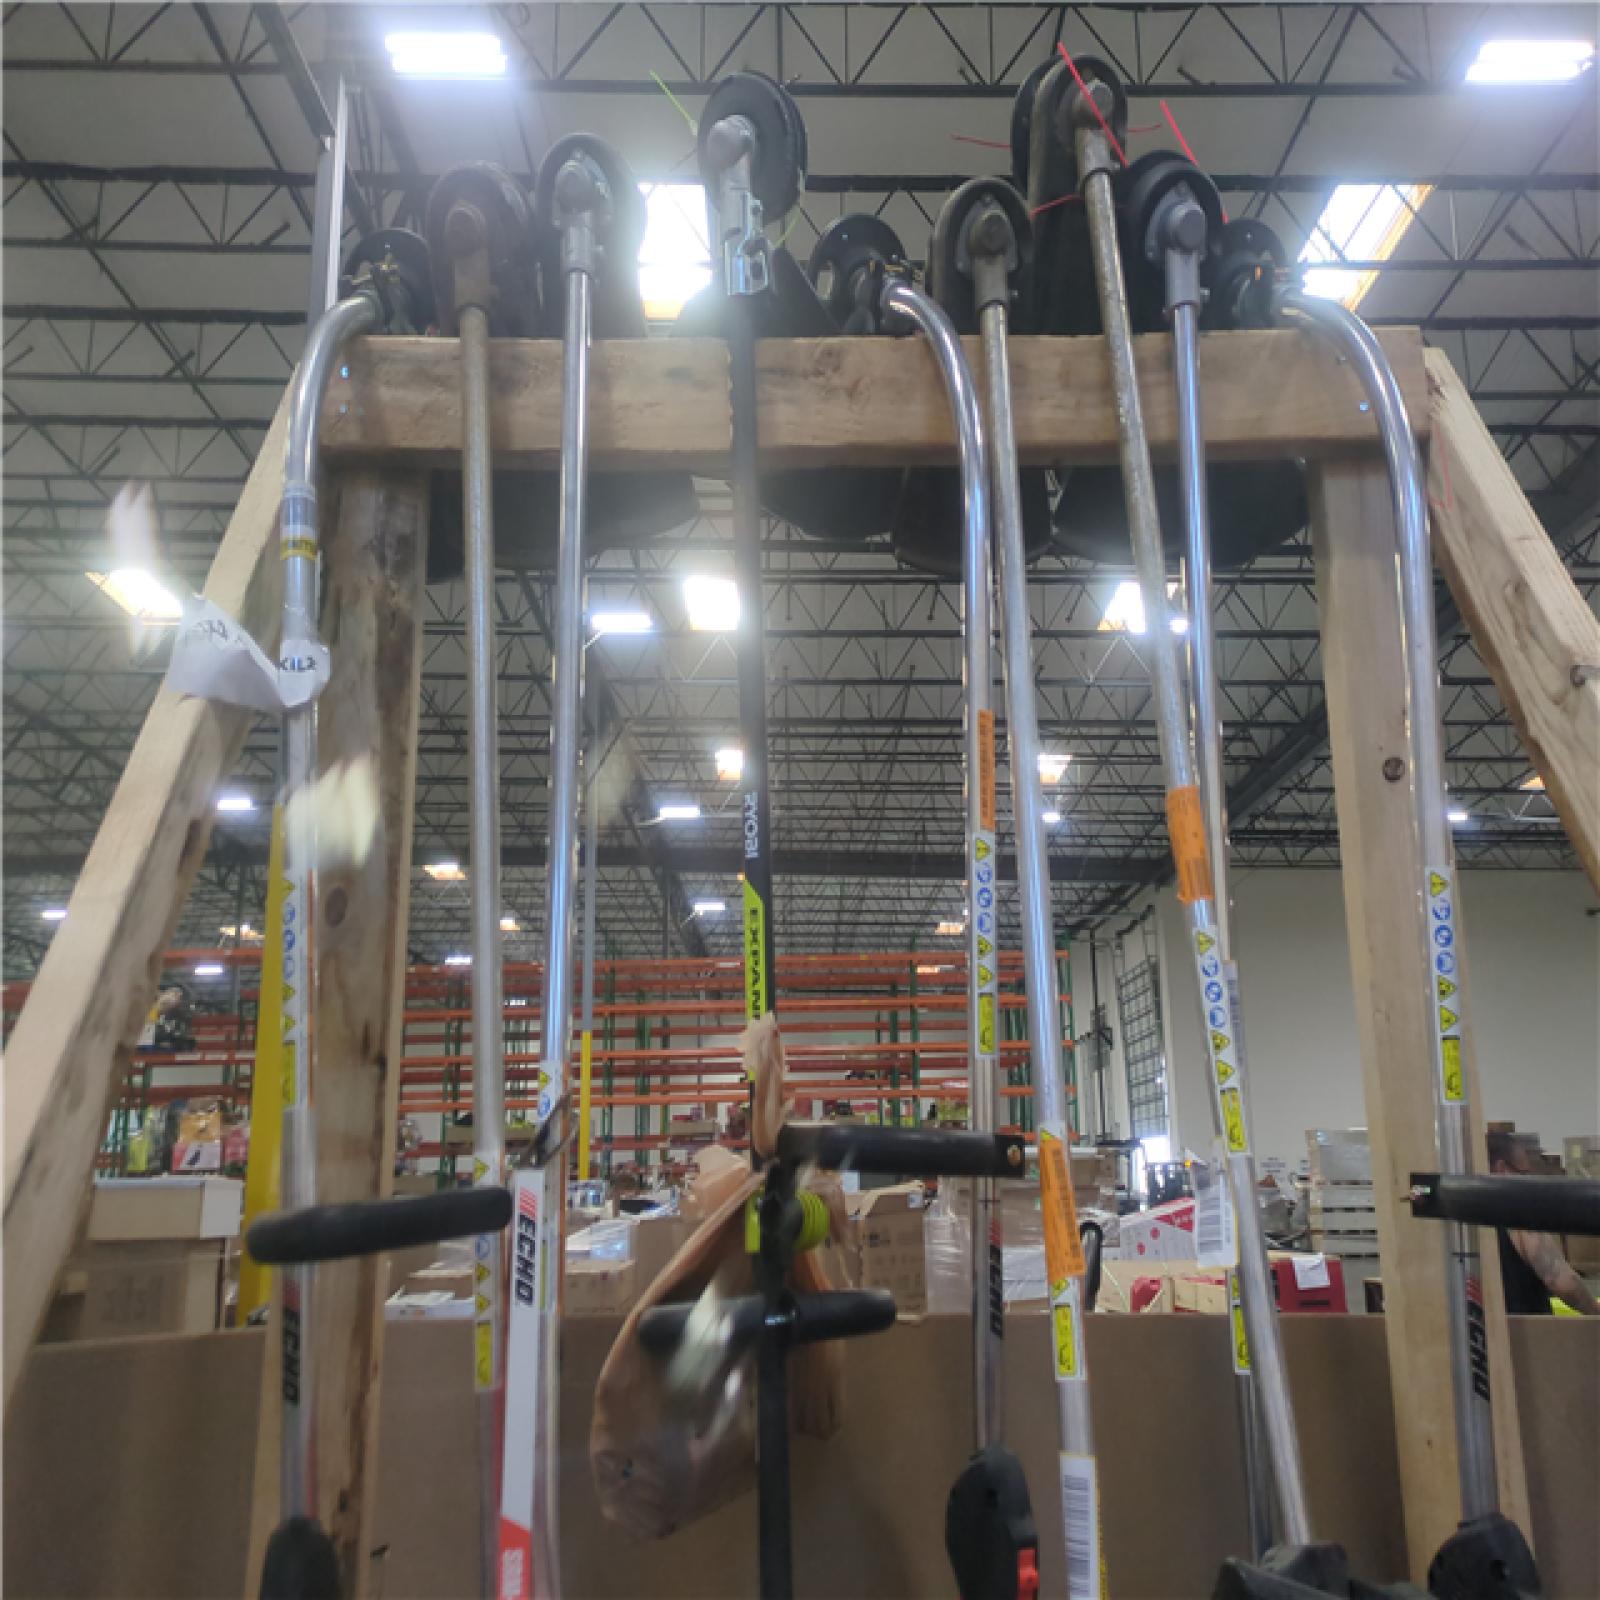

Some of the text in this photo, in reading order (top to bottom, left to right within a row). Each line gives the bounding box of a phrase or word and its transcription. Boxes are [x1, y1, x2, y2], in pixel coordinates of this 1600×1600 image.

[750, 907, 761, 1020] EXPAN
[516, 1213, 536, 1306] ECHO
[282, 1306, 299, 1406] ECHO
[1467, 1300, 1491, 1402] ECHO
